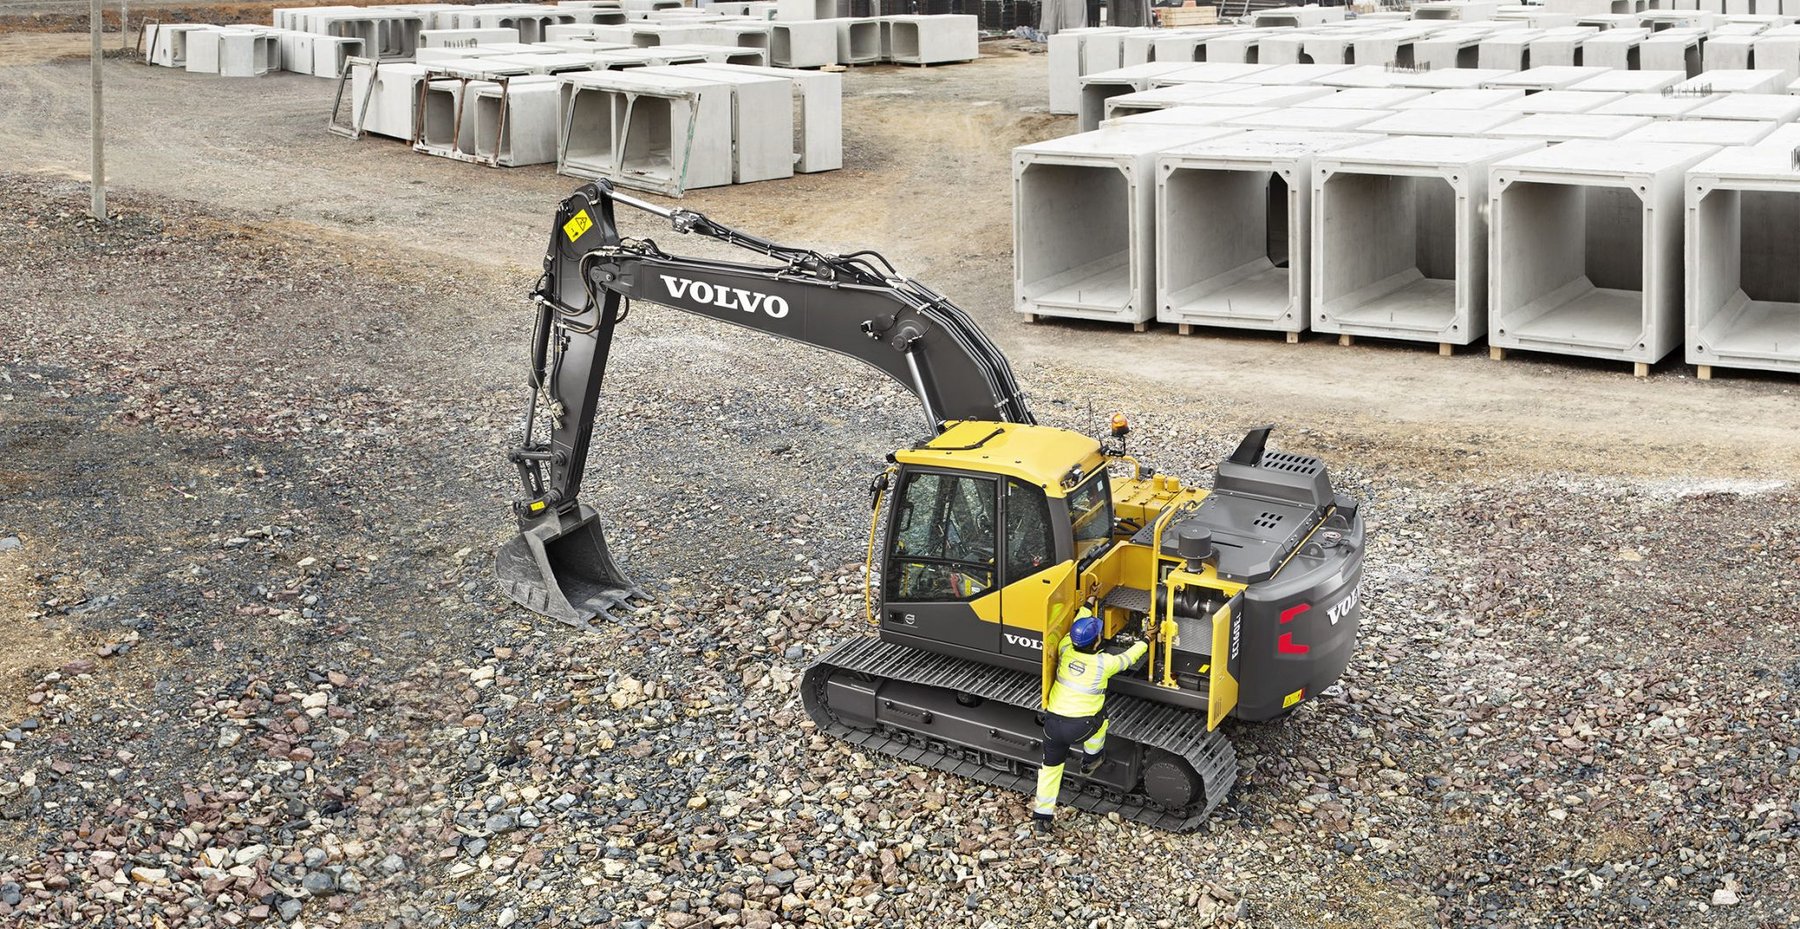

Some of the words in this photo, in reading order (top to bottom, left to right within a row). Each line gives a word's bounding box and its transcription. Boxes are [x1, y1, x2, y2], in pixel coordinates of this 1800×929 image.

[660, 274, 789, 319] VOLVO
[1326, 581, 1360, 626] VOL
[1004, 633, 1043, 650] VOL
